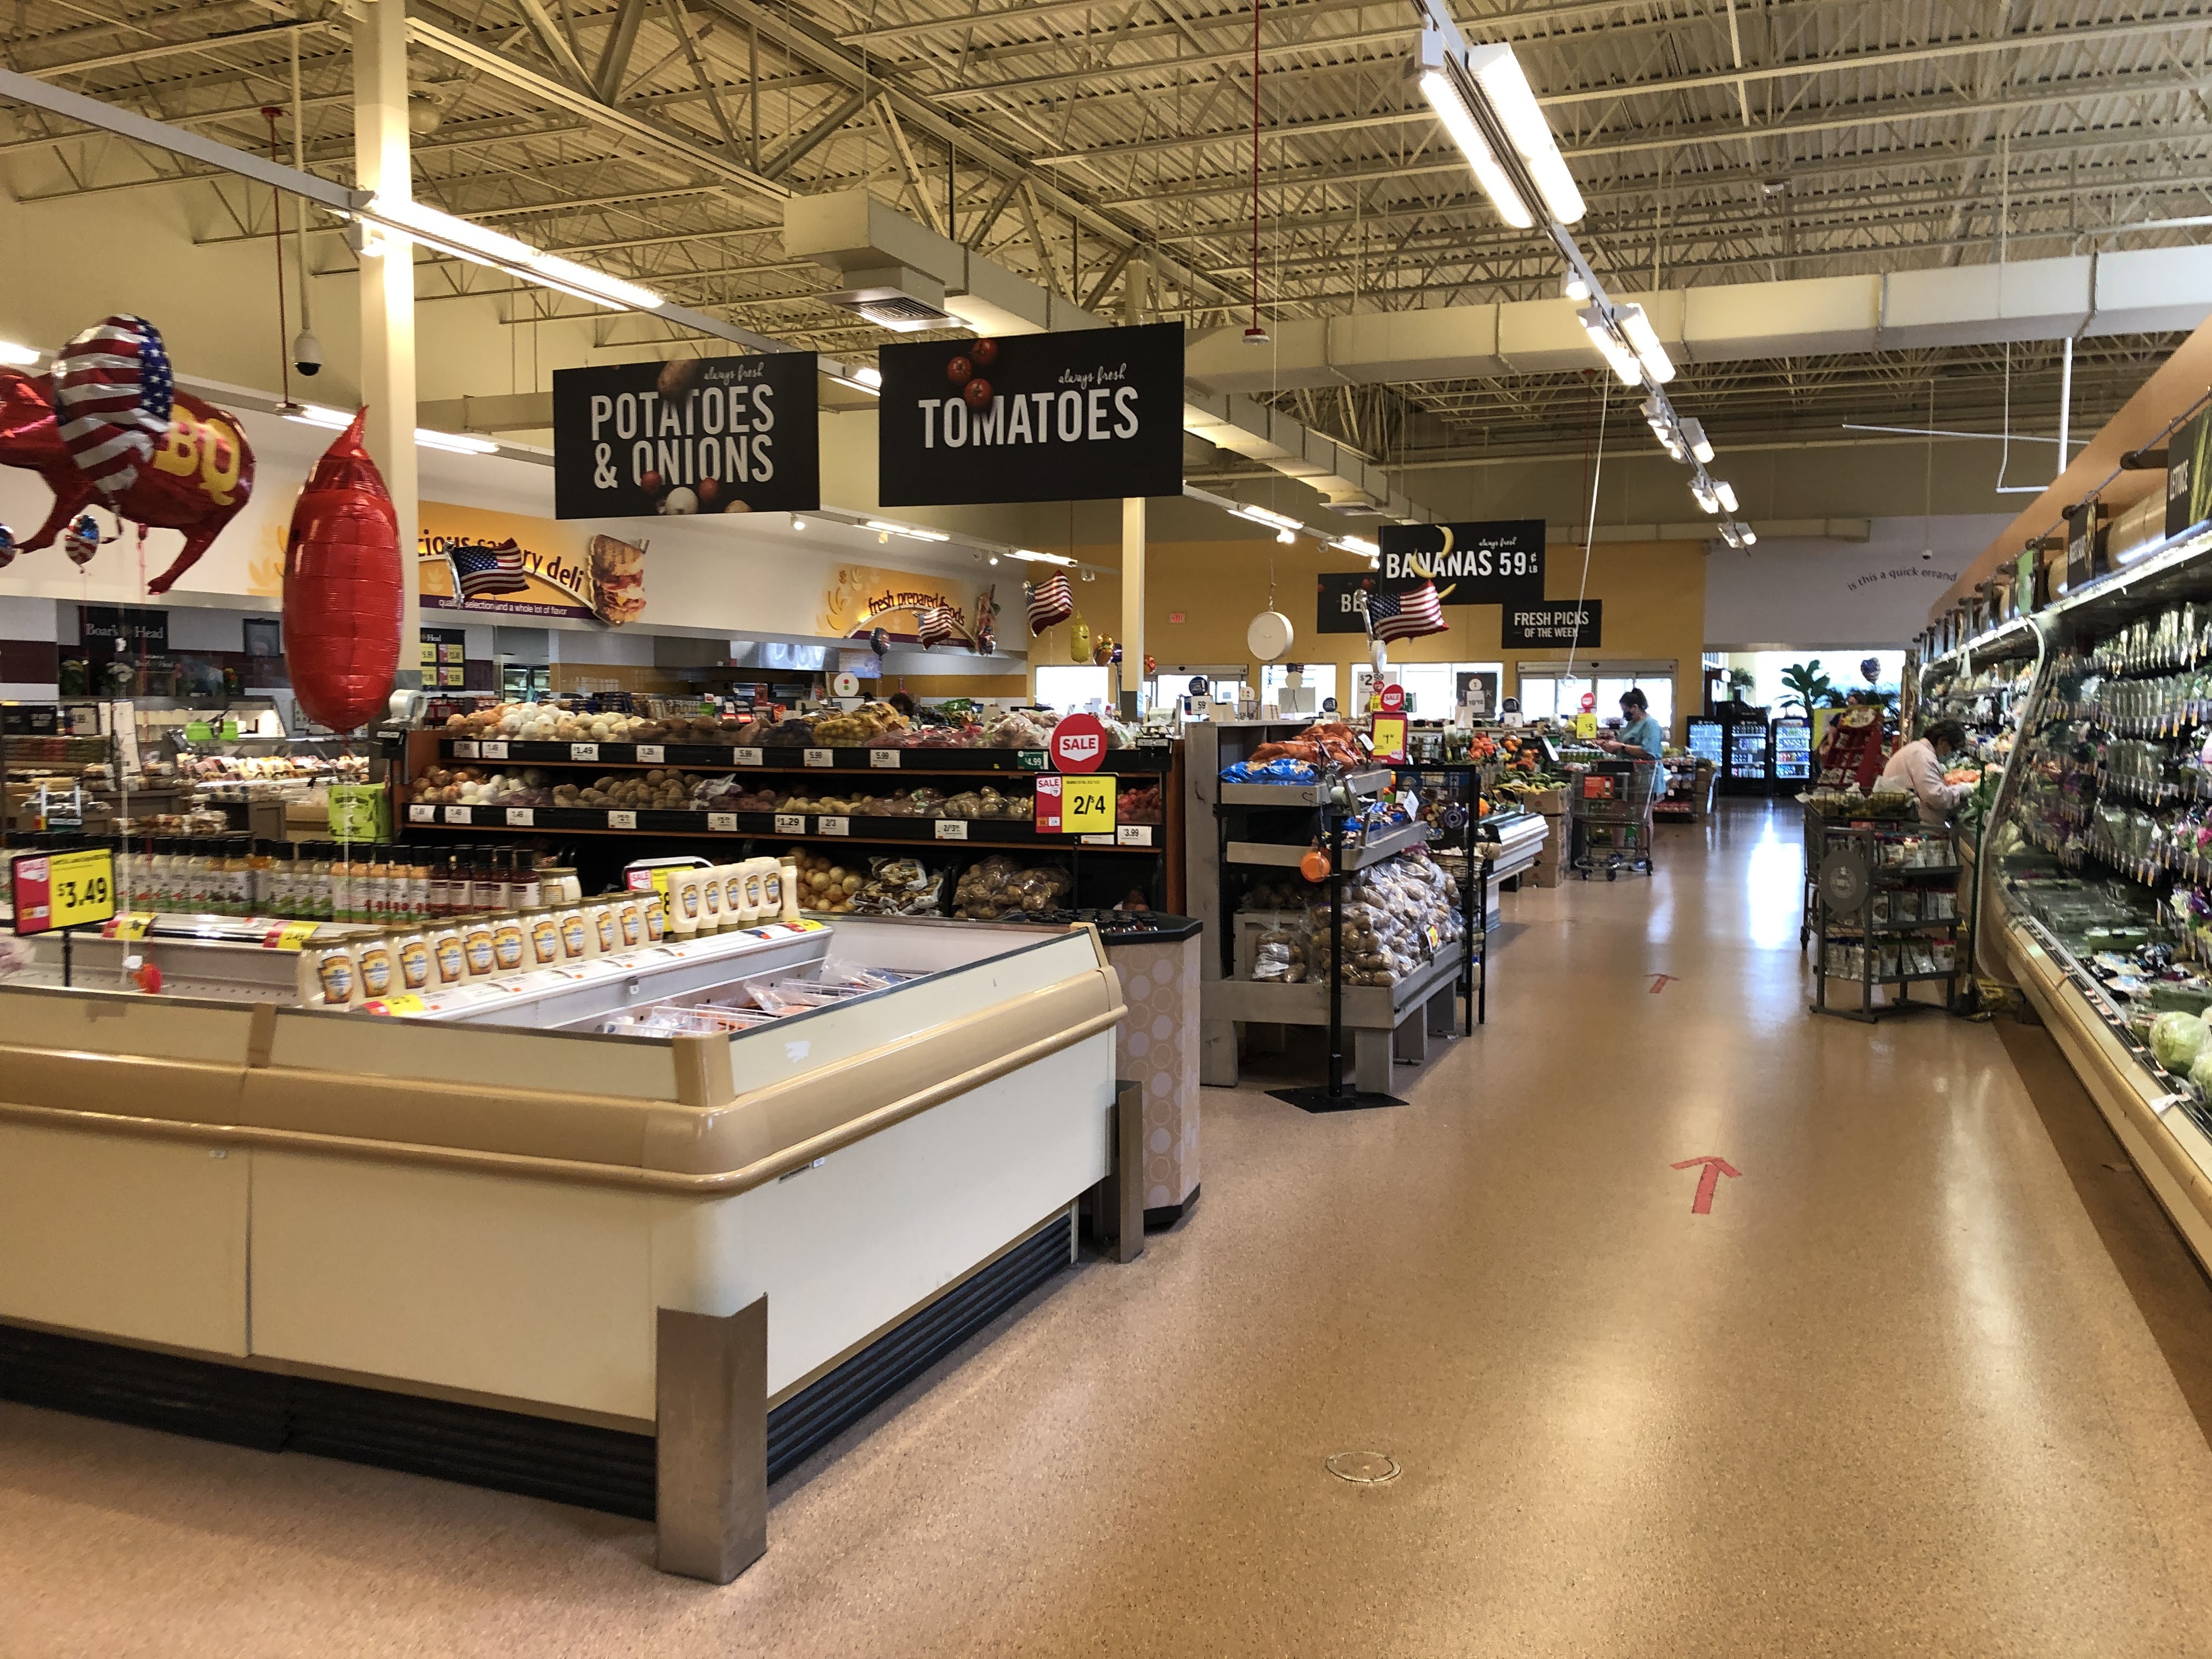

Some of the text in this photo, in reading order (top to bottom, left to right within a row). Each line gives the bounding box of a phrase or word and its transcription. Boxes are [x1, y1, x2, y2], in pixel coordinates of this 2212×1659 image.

[704, 362, 765, 385] always fresh
[1058, 363, 1127, 389] always fresh
[590, 384, 775, 441] POTATOES
[918, 386, 1139, 448] TOMATOES
[154, 403, 241, 506] BQ
[593, 434, 775, 489] & ONIONS
[547, 556, 584, 592] deli
[1386, 550, 1493, 579] BANANAS
[1499, 551, 1526, 576] 59
[1847, 583, 1857, 591] is
[1858, 573, 1878, 585] this
[1889, 567, 1918, 579] quick
[465, 600, 494, 610] selection
[495, 602, 509, 611] and
[515, 604, 533, 613] whole
[534, 605, 543, 613] lot
[550, 606, 568, 615] flavor
[868, 590, 895, 616] fresh
[897, 592, 939, 609] prepared
[1514, 611, 1589, 626] FRESH PICKS
[134, 625, 164, 639] Head
[1524, 627, 1578, 638] OF THE WEEK
[1062, 737, 1096, 751] SALE
[1038, 778, 1059, 788] SALE
[1074, 794, 1106, 815] 2/$4
[777, 817, 800, 826] $1.29
[57, 876, 108, 908] $3.49
